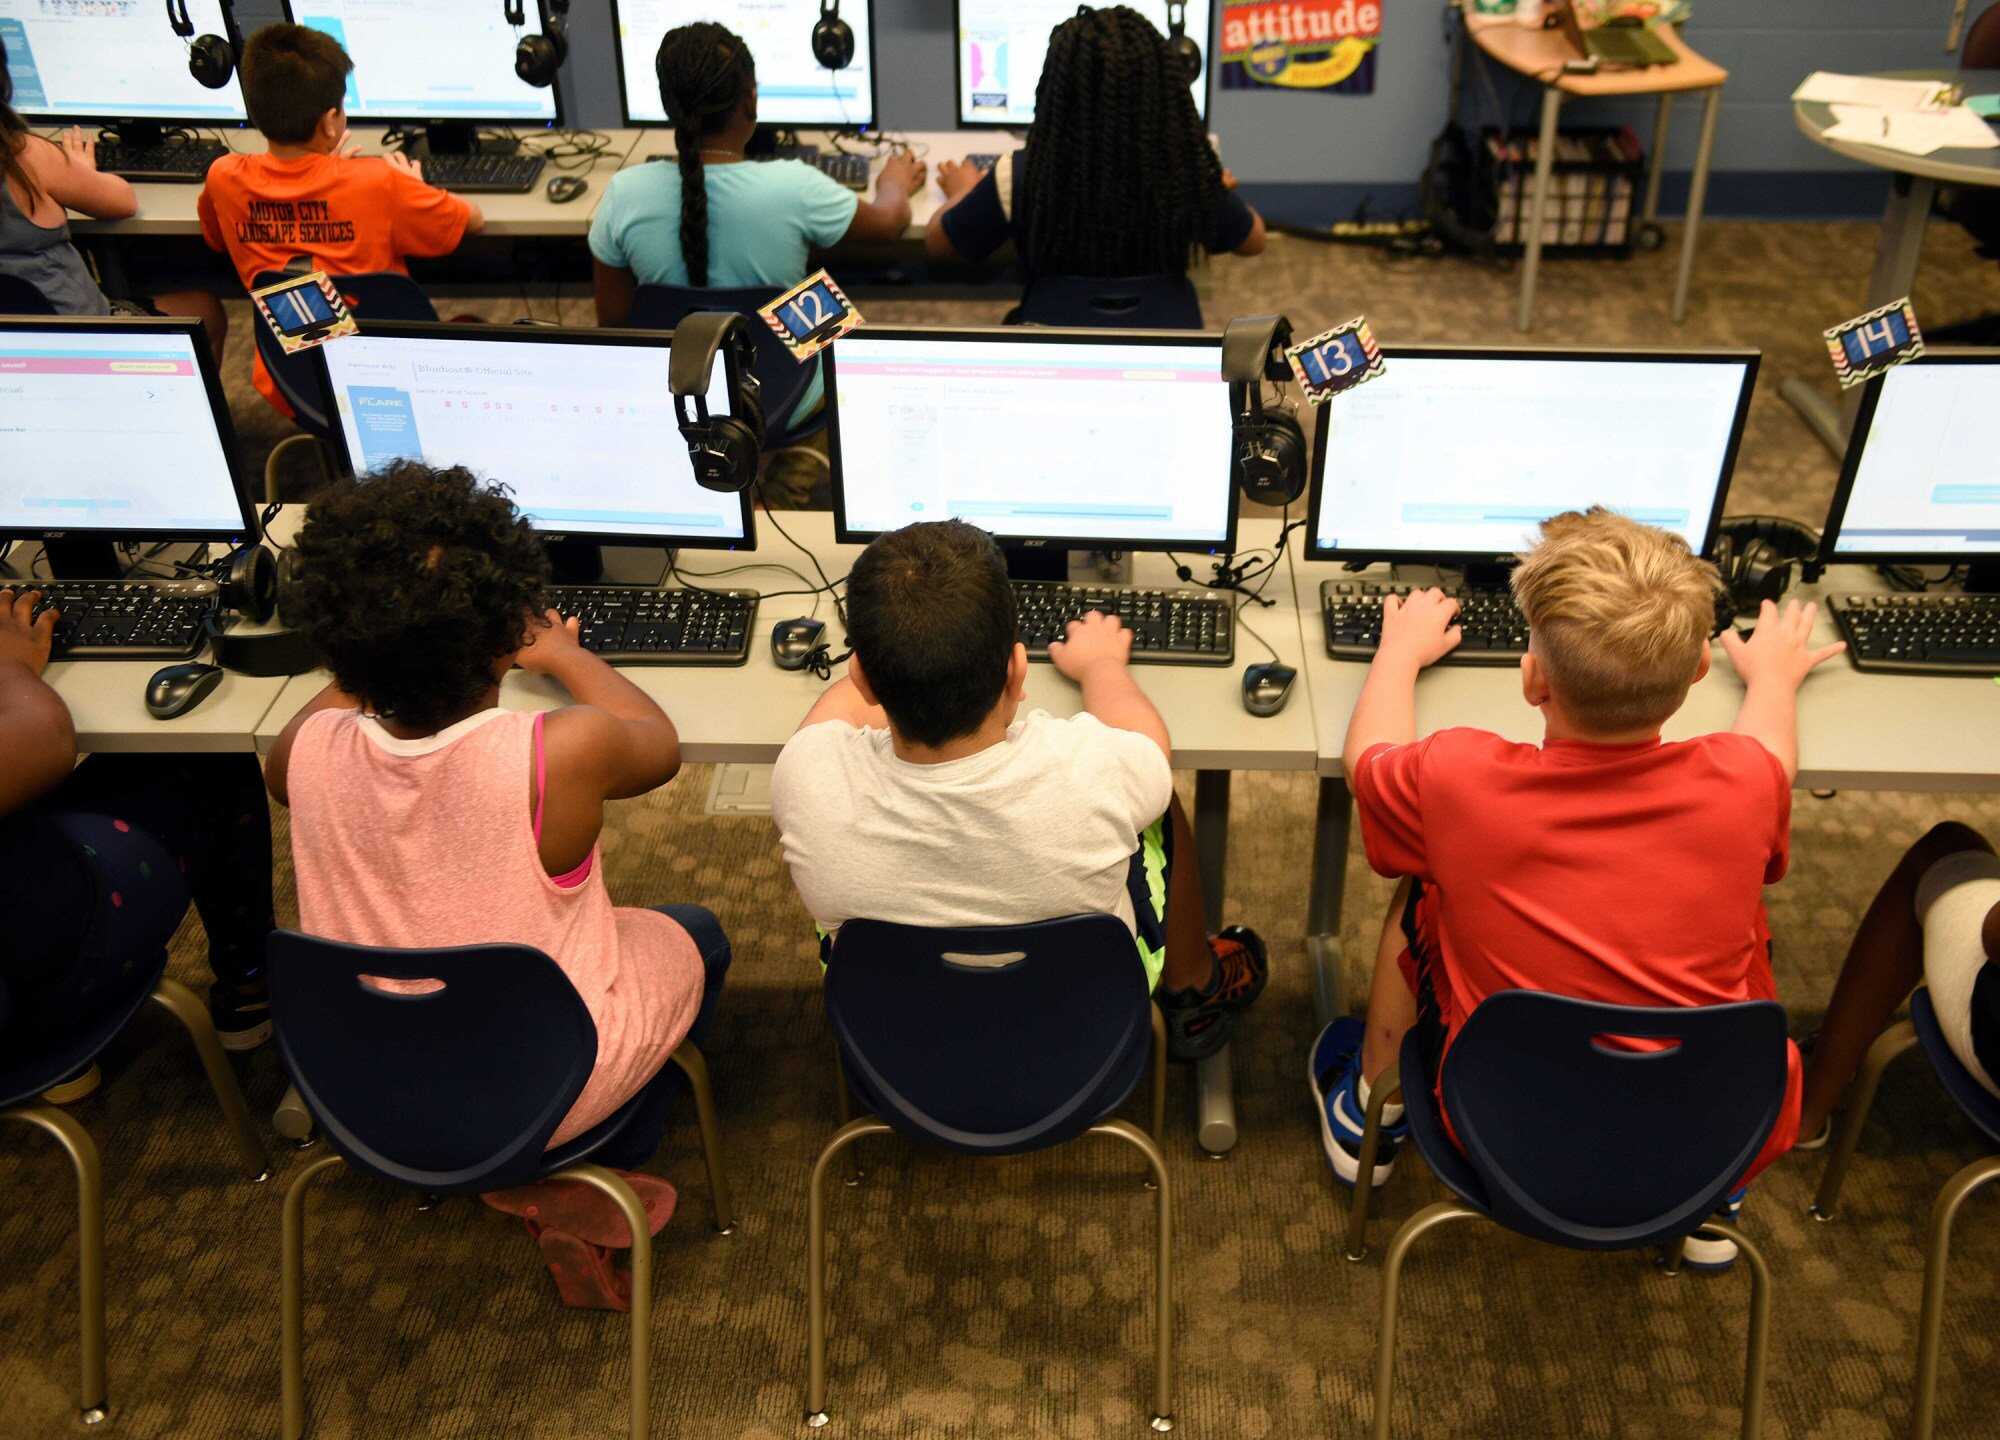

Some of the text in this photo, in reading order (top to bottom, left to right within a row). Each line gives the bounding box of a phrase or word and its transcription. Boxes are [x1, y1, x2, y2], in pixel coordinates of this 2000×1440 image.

[1224, 0, 1379, 48] attitude
[247, 200, 328, 221] MOTOR CITY
[235, 220, 355, 243] LANDSCAPE SERVICES
[286, 289, 316, 325] 11
[789, 290, 833, 330] 12
[1856, 316, 1896, 358] 14
[1313, 340, 1352, 380] 13
